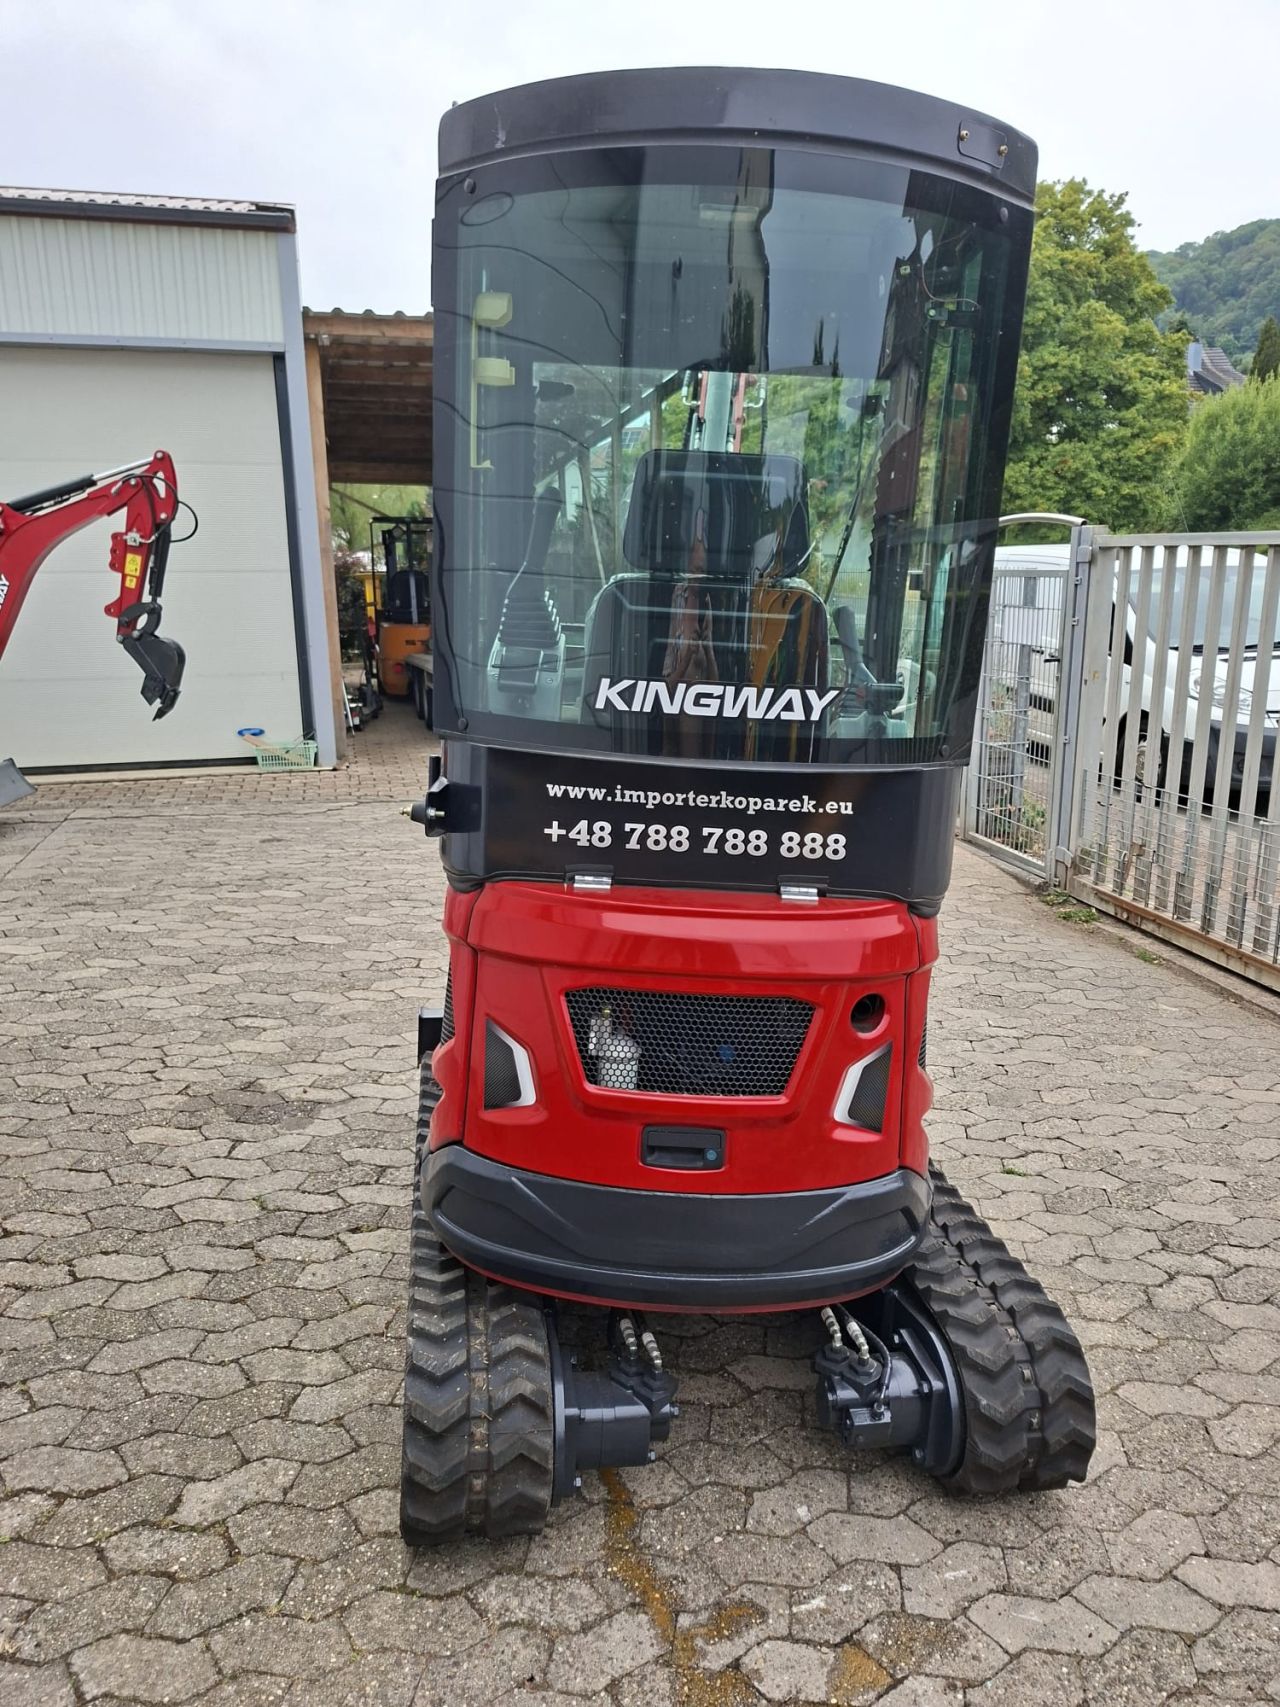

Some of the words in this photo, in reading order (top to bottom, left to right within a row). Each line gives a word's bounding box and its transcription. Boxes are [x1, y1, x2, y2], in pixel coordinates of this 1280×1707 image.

[595, 677, 840, 721] KINGWAY
[546, 783, 854, 815] www.importerkoparek.eu
[543, 819, 612, 848] +48
[624, 822, 690, 853] 788
[702, 827, 768, 857] 788
[779, 831, 847, 860] 888
